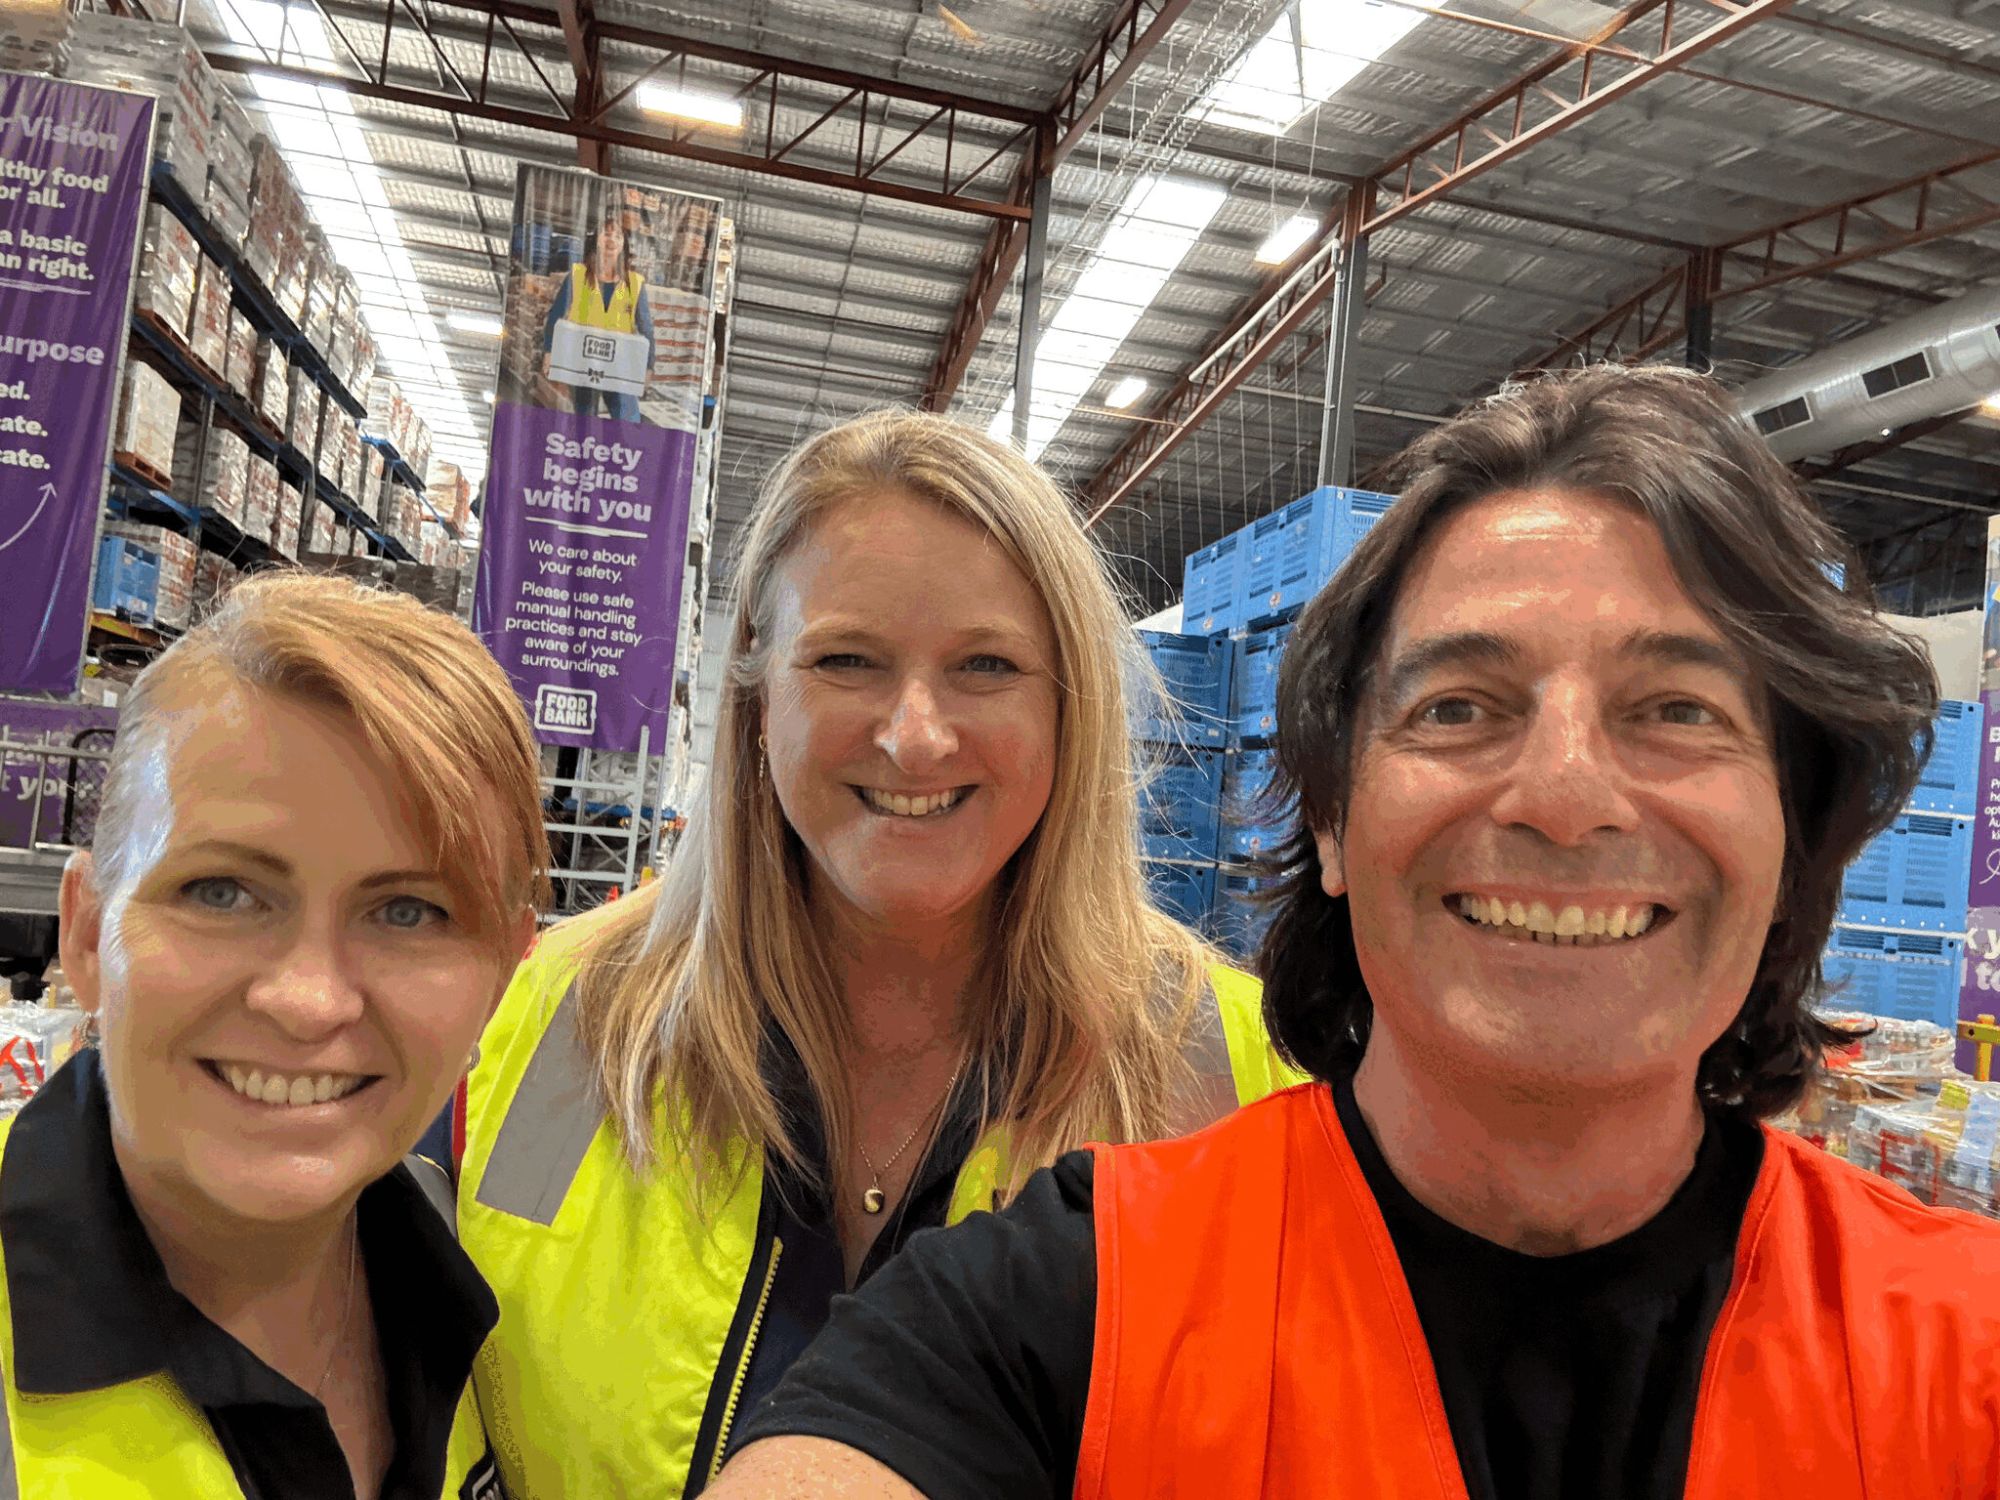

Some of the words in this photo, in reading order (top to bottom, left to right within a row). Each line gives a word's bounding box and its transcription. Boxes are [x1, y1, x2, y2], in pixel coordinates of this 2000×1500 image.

[20, 114, 118, 152] Vision
[52, 167, 109, 193] food
[27, 187, 66, 209] all.
[0, 230, 13, 245] a
[20, 229, 88, 257] basic
[28, 254, 95, 281] right.
[545, 432, 643, 472] Safety
[543, 457, 639, 493] begins
[523, 485, 591, 514] with
[597, 498, 652, 523] you
[528, 538, 554, 555] We
[557, 546, 589, 560] care
[592, 548, 638, 567] about
[539, 560, 573, 575] your
[576, 564, 622, 584] safety.
[522, 580, 570, 601] Please
[573, 592, 599, 604] use
[603, 593, 635, 609] safe
[515, 600, 571, 619] manual
[574, 606, 637, 630] handling
[505, 616, 575, 637] practices
[578, 626, 607, 640] and
[610, 630, 643, 648] stay
[524, 636, 569, 654] aware
[573, 641, 588, 655] of
[591, 645, 626, 659] your
[521, 653, 620, 679] surroundings.
[546, 692, 588, 712] FOOD
[544, 707, 588, 727] BANK
